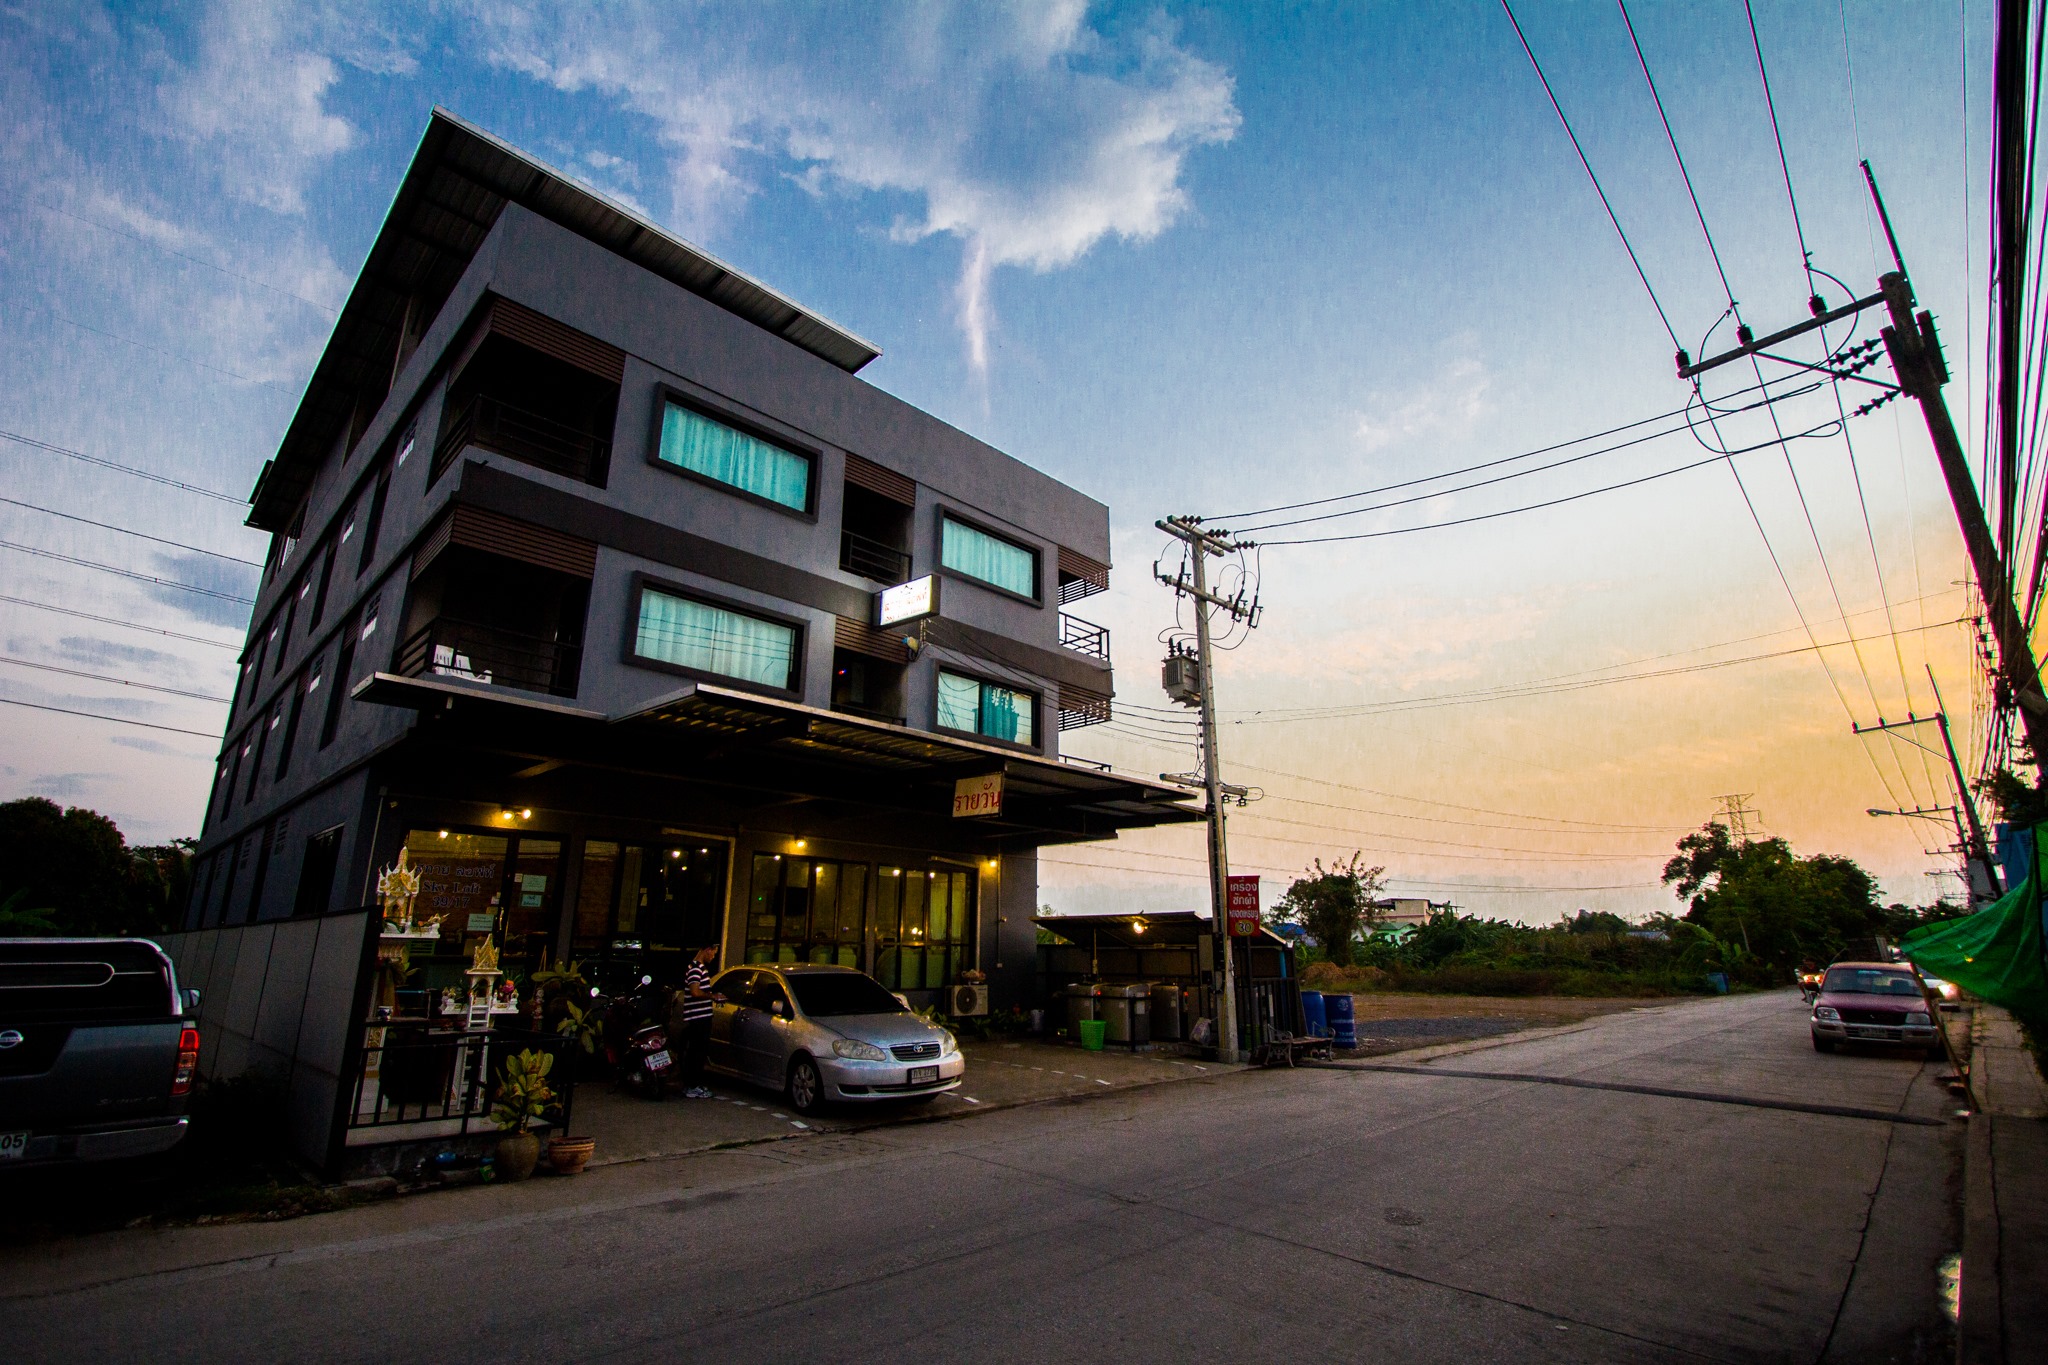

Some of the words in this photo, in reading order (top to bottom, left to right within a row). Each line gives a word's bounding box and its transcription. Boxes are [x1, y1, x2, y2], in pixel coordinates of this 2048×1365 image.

[954, 782, 1001, 811] รายวัน
[422, 880, 448, 895] Sky
[452, 881, 482, 895] Loft
[1230, 876, 1258, 892] เครื่อง
[432, 895, 471, 909] 39/17
[1232, 892, 1256, 906] ซักผ้า
[1238, 922, 1252, 933] 30
